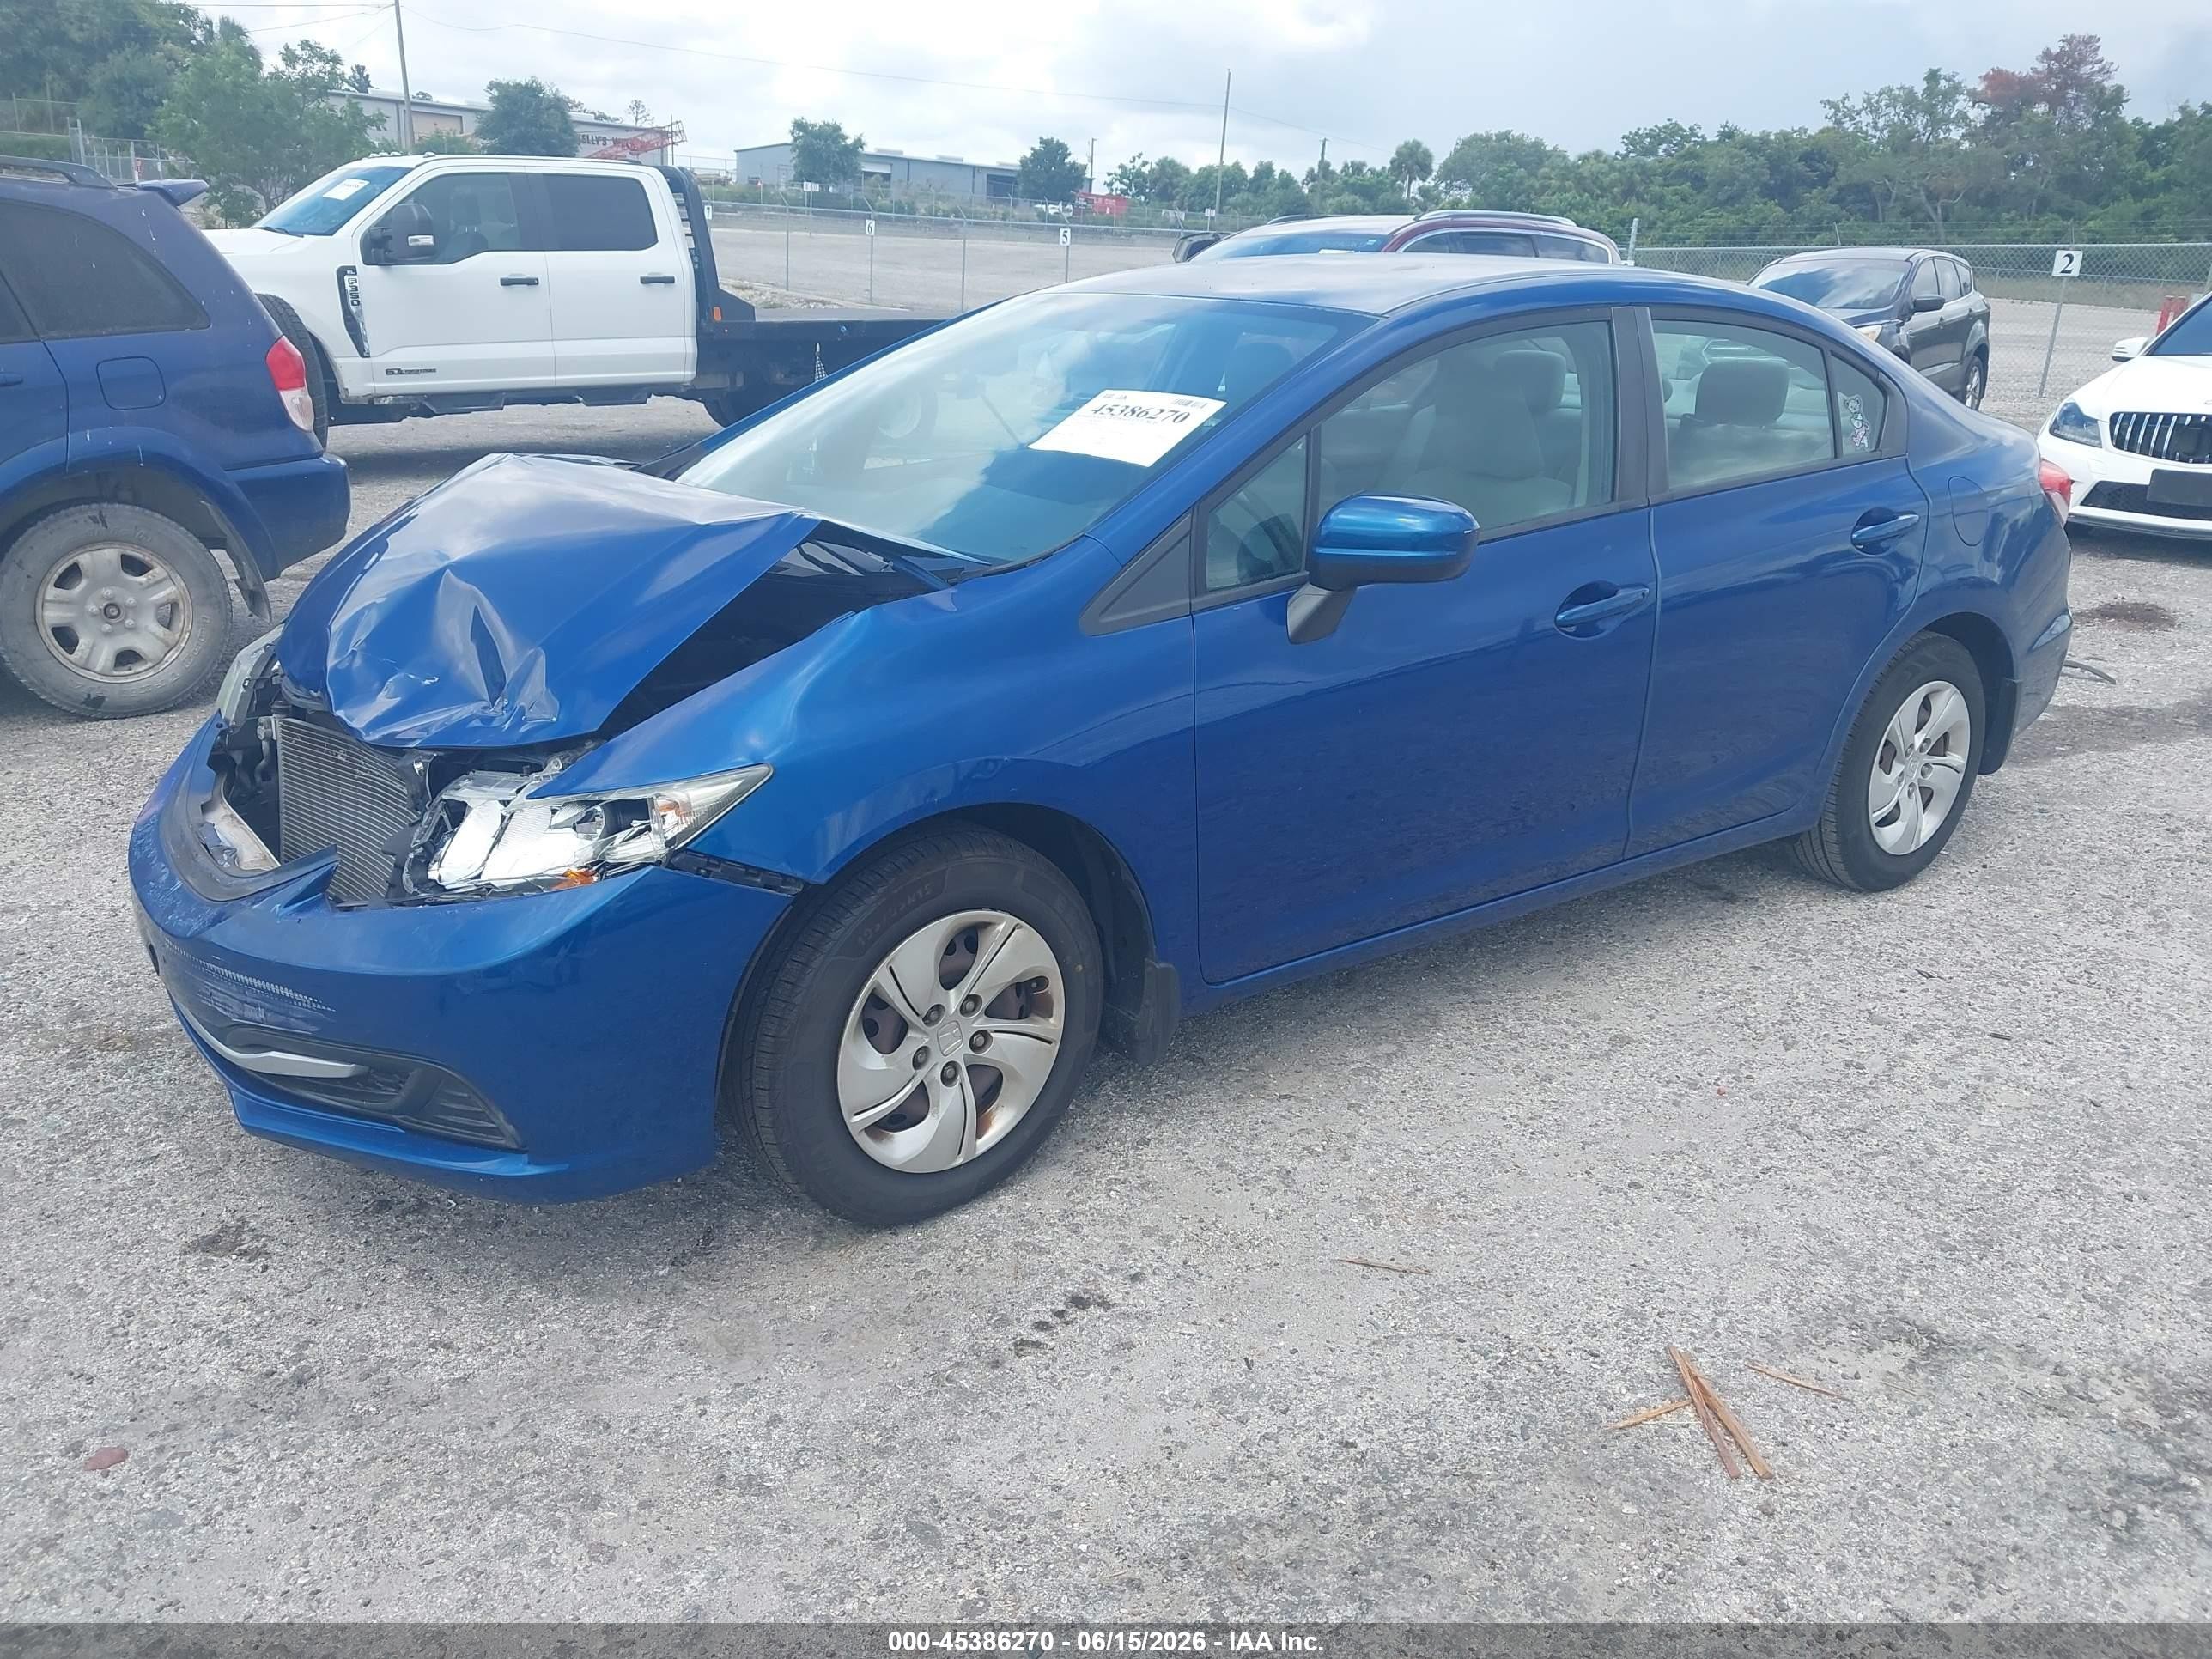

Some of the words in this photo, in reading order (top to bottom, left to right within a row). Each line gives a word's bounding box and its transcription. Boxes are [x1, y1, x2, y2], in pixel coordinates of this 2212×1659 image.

[1061, 229, 1069, 244] 5
[2060, 252, 2075, 274] 2
[1091, 404, 1191, 423] 45386270
